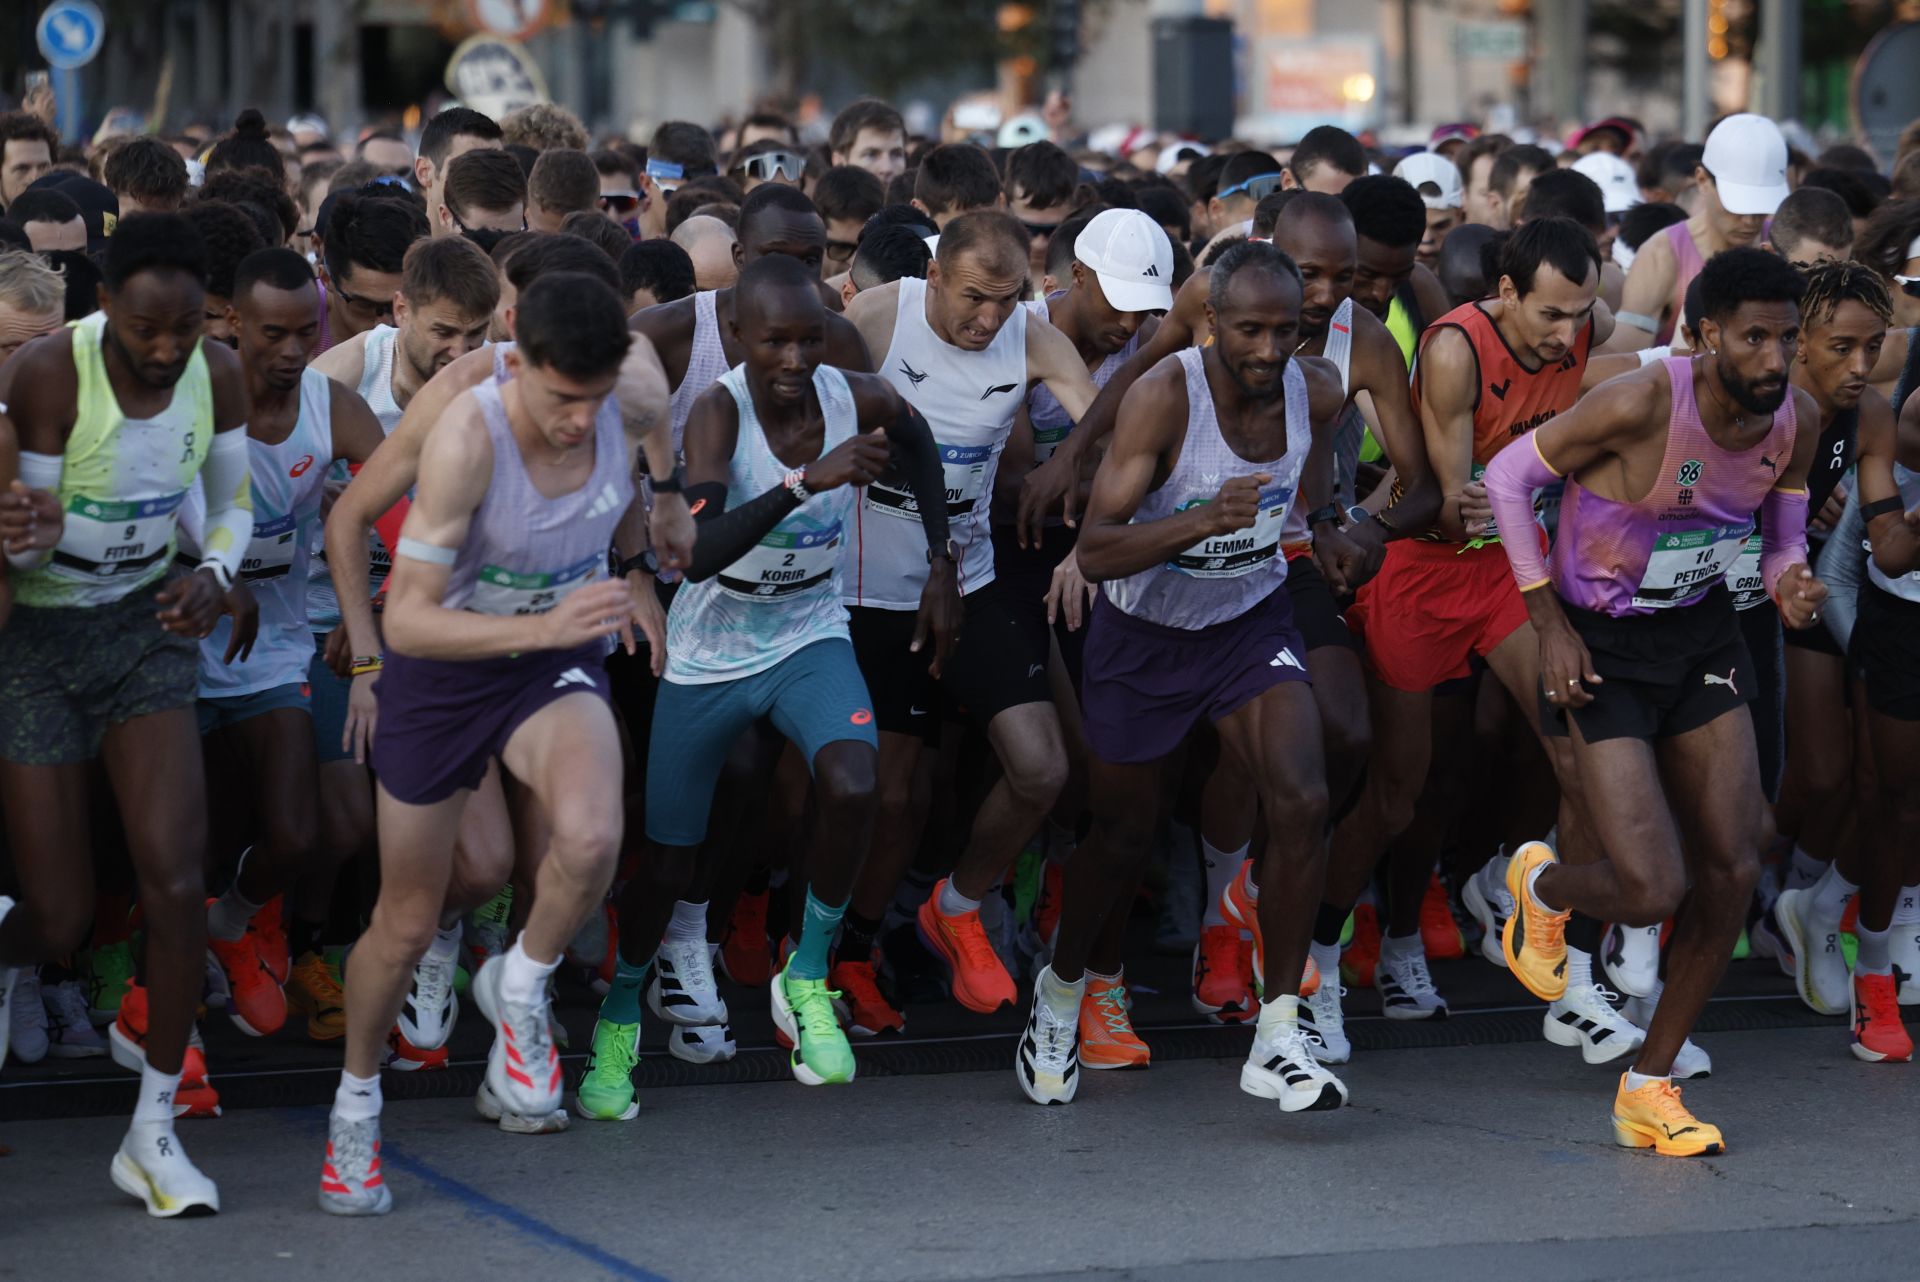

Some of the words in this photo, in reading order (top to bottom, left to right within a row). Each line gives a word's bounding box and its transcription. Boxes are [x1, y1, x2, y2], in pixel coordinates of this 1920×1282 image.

[1678, 463, 1700, 482] 96
[124, 524, 137, 541] 9
[104, 543, 145, 560] FITWI
[1204, 537, 1255, 555] LEMMA
[782, 553, 796, 566] 2
[1696, 548, 1714, 564] 10
[761, 568, 806, 582] KORIR
[1673, 561, 1720, 585] PETROS
